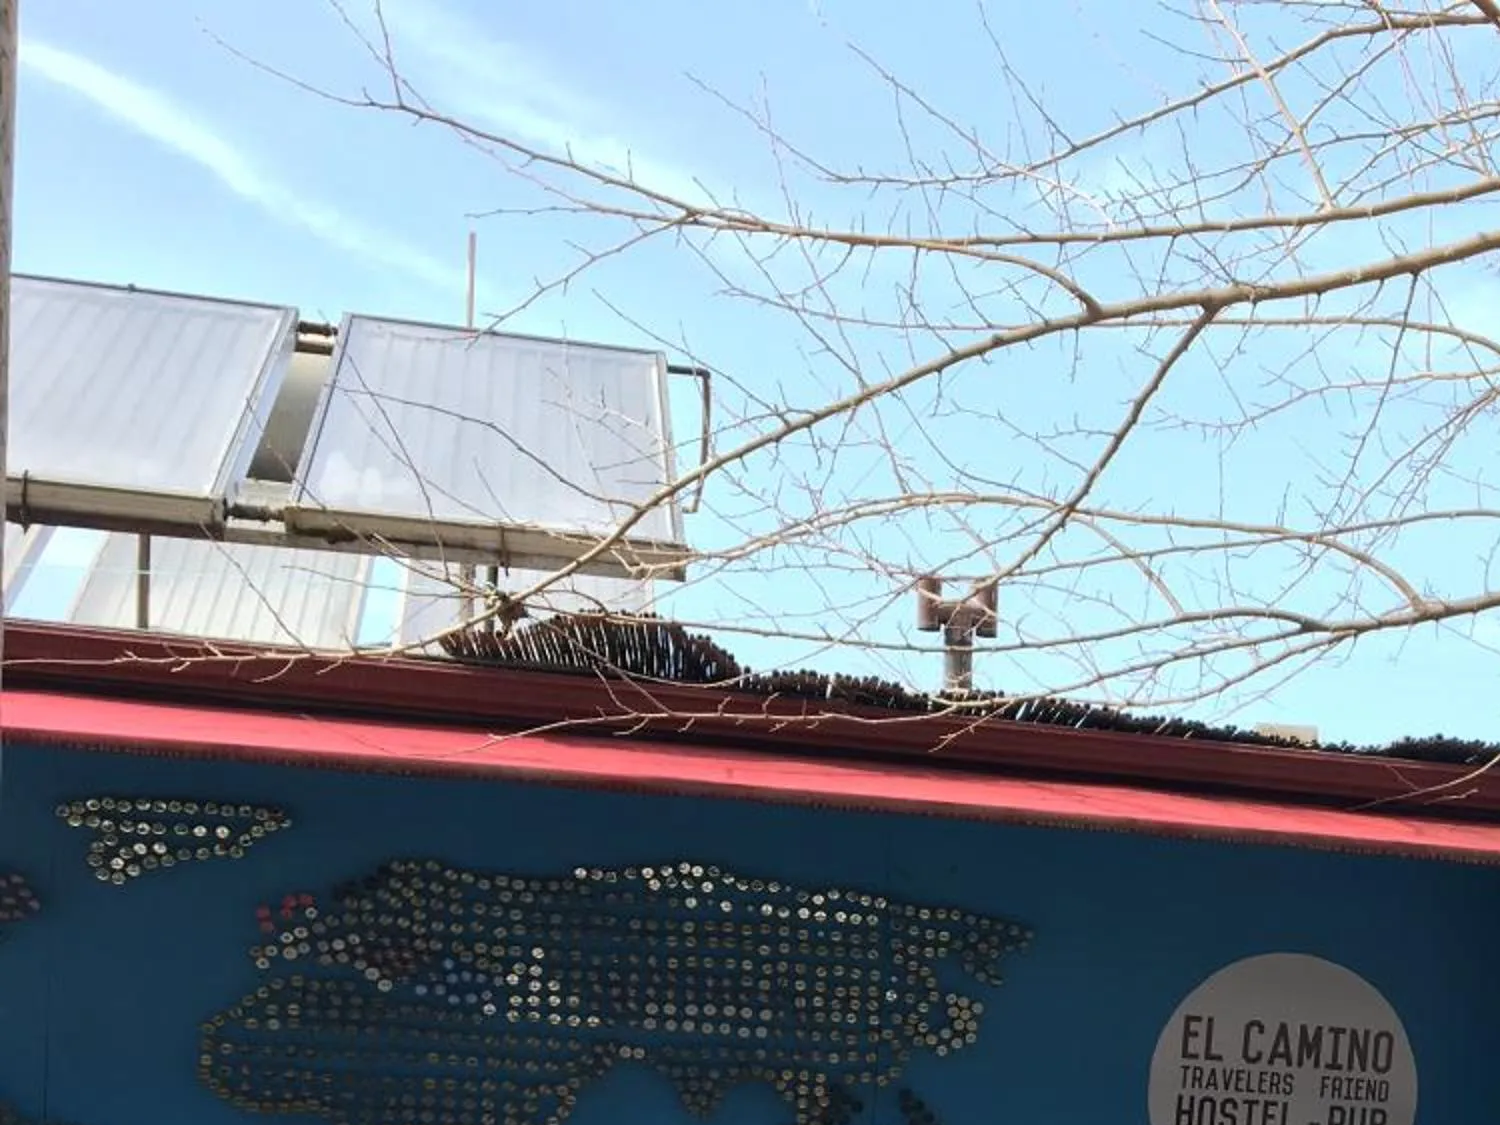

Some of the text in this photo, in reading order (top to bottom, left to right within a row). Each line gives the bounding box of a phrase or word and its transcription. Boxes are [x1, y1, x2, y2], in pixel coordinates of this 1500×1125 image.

[1180, 1014, 1395, 1074] EL CAMINO
[1181, 1065, 1390, 1103] TRAVELERS FRIEND
